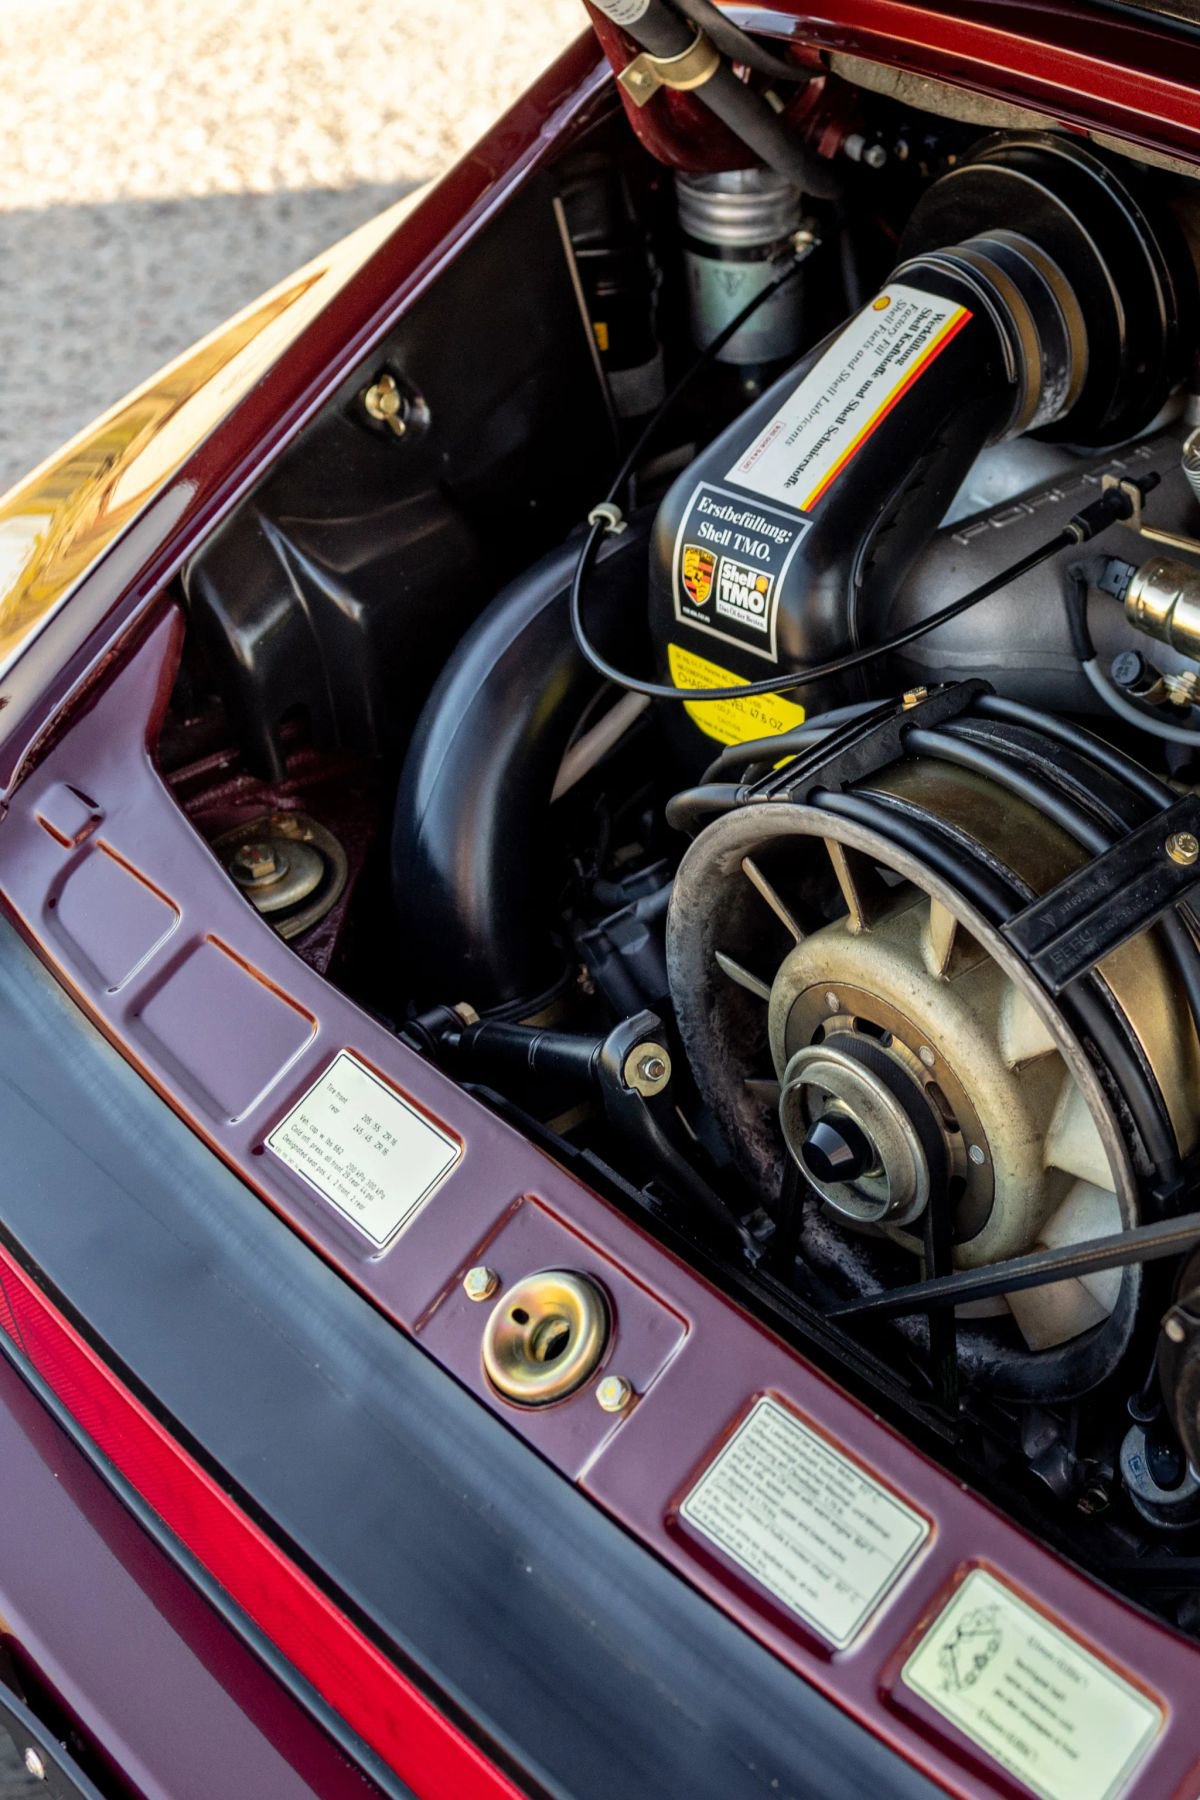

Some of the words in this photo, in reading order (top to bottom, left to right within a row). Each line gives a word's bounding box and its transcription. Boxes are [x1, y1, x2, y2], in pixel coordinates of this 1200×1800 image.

[881, 299, 908, 323] Shell
[884, 303, 920, 338] Factory
[906, 307, 933, 331] Shell
[861, 324, 888, 349] Fuels
[871, 338, 892, 355] Fill
[894, 312, 946, 366] Werkfüllung
[845, 349, 867, 369] and
[869, 332, 914, 378] Kraftstoffe
[825, 369, 851, 394] Shell
[853, 379, 875, 398] und
[782, 395, 831, 446] Lubricants
[833, 399, 860, 424] Shell
[780, 425, 841, 489] Schmierstoffe
[698, 496, 879, 544] Erstbefüllung:
[697, 520, 732, 547] Shell
[733, 532, 771, 563] TMO.
[722, 562, 757, 590] Shell
[721, 578, 765, 614] TMO
[325, 1082, 338, 1094] Tire
[335, 1090, 349, 1104] front
[328, 1103, 340, 1114] rear
[290, 1123, 303, 1136] Cold
[330, 1159, 343, 1173] front
[348, 1176, 360, 1188] rear
[280, 1133, 308, 1159] Designated
[306, 1156, 318, 1168] seat
[353, 1199, 365, 1211] rear
